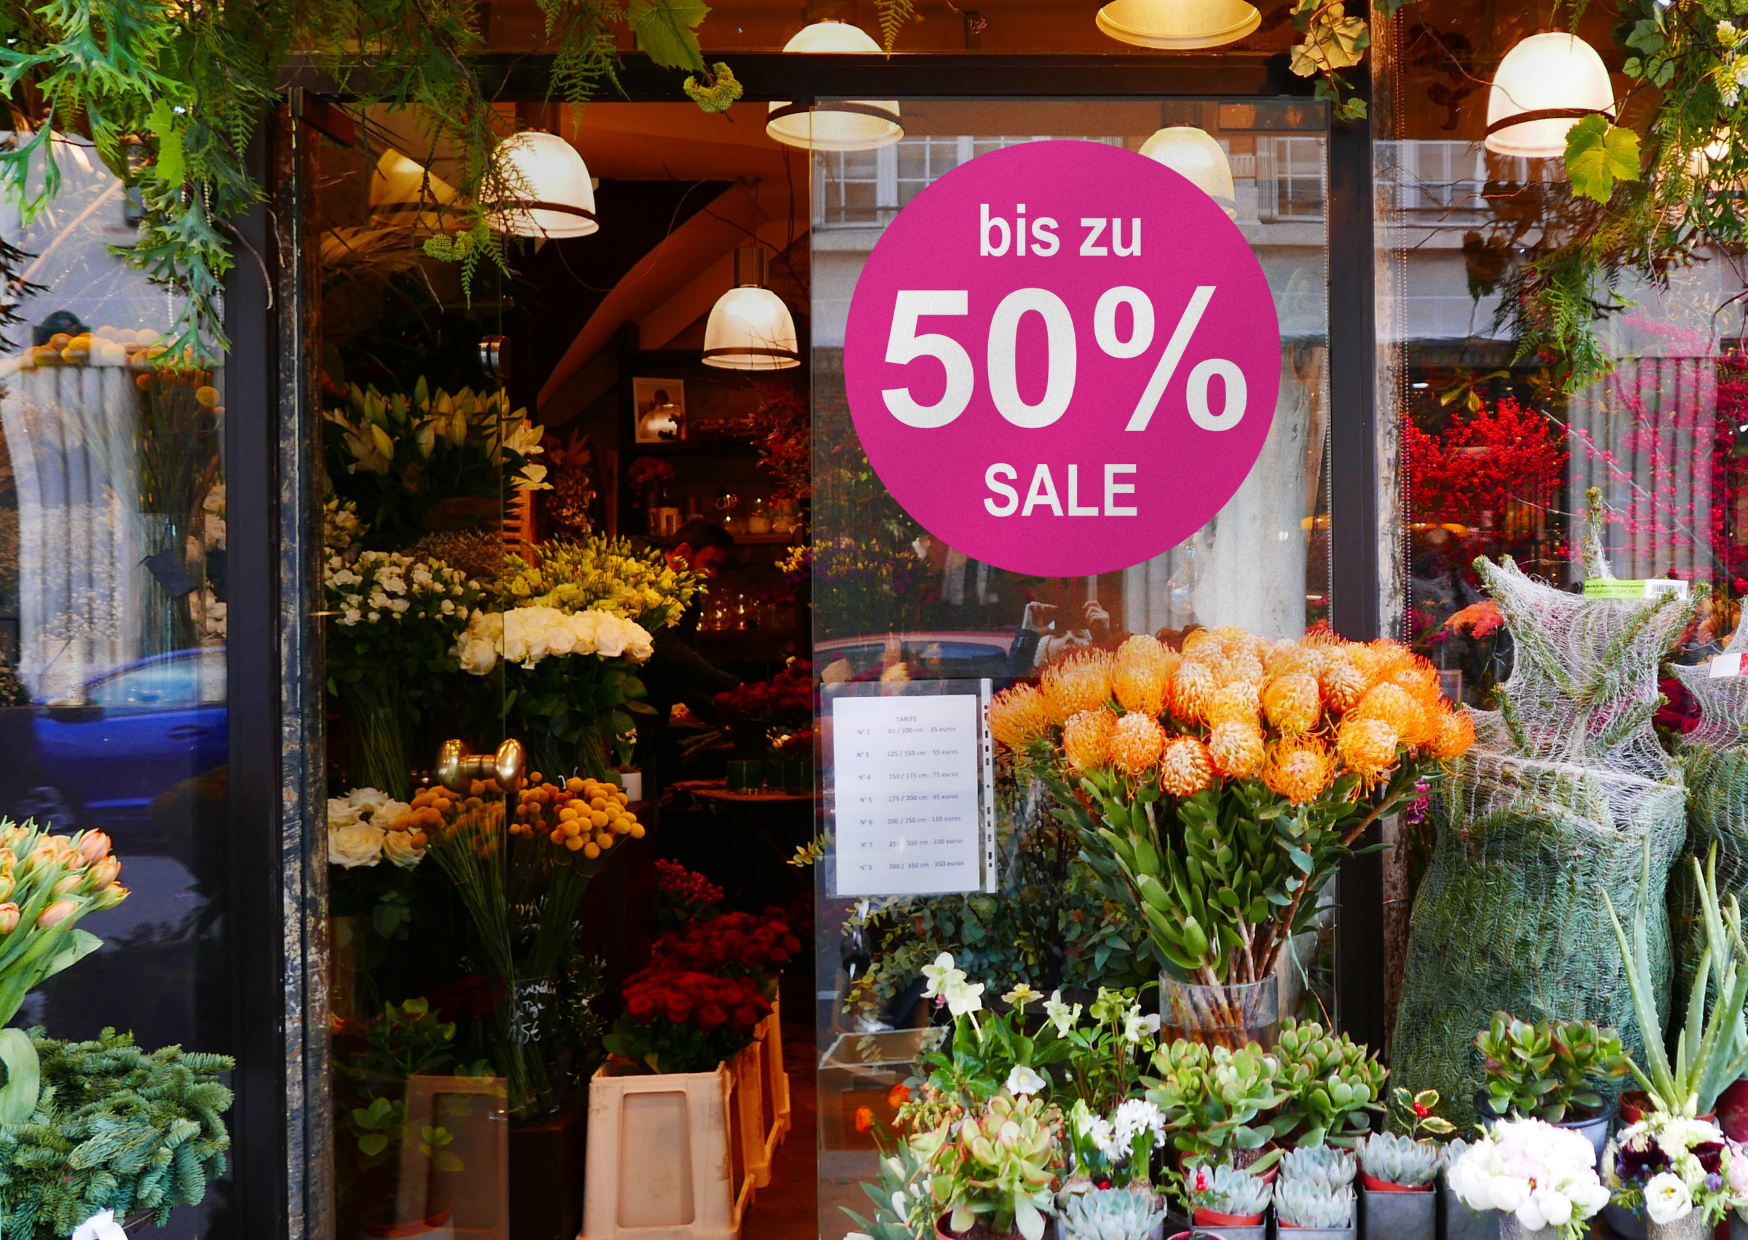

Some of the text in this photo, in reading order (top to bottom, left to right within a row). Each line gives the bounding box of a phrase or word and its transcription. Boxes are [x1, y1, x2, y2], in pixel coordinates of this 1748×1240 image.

[979, 203, 1142, 257] bis zu
[881, 285, 1248, 432] 50%
[983, 463, 1138, 517] SALE
